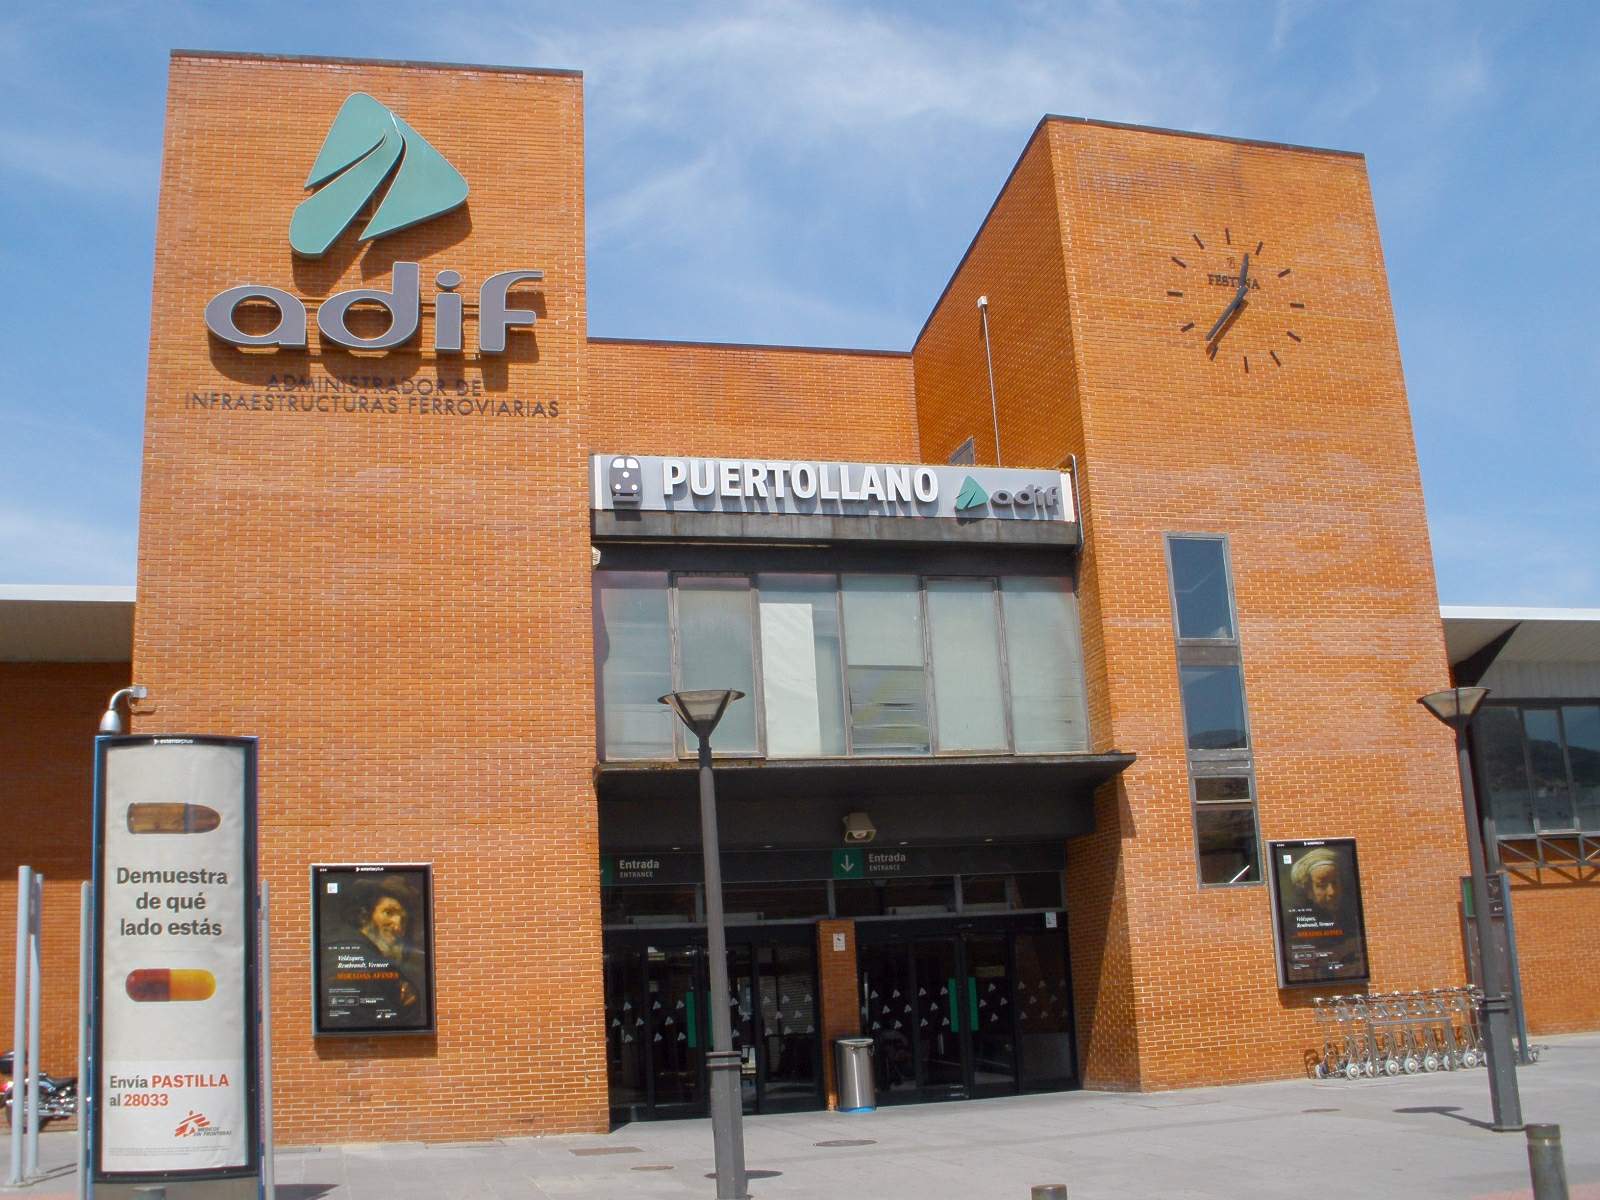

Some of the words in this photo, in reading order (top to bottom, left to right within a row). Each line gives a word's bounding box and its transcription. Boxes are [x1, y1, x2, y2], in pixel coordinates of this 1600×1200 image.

[1206, 273, 1261, 290] FESTA
[204, 261, 544, 353] adif
[265, 373, 447, 396] ADMINISTRADOR
[456, 378, 482, 397] DE
[185, 391, 399, 414] INFRAESTRUCTURAS
[408, 397, 559, 418] FERROVIARIAS
[662, 458, 939, 504] PUERTOLLANO
[990, 484, 1059, 507] adif
[619, 859, 660, 870] Entrada
[868, 852, 906, 863] Entrada
[116, 867, 228, 885] Demuestra
[620, 871, 654, 879] ENTRANCE
[135, 892, 162, 909] de
[166, 892, 206, 913] qué
[120, 918, 163, 936] lado
[167, 918, 222, 936] estás
[109, 1075, 148, 1089] Envía
[151, 1073, 230, 1088] PASTILLA
[109, 1094, 121, 1107] al
[123, 1093, 169, 1107] 28033
